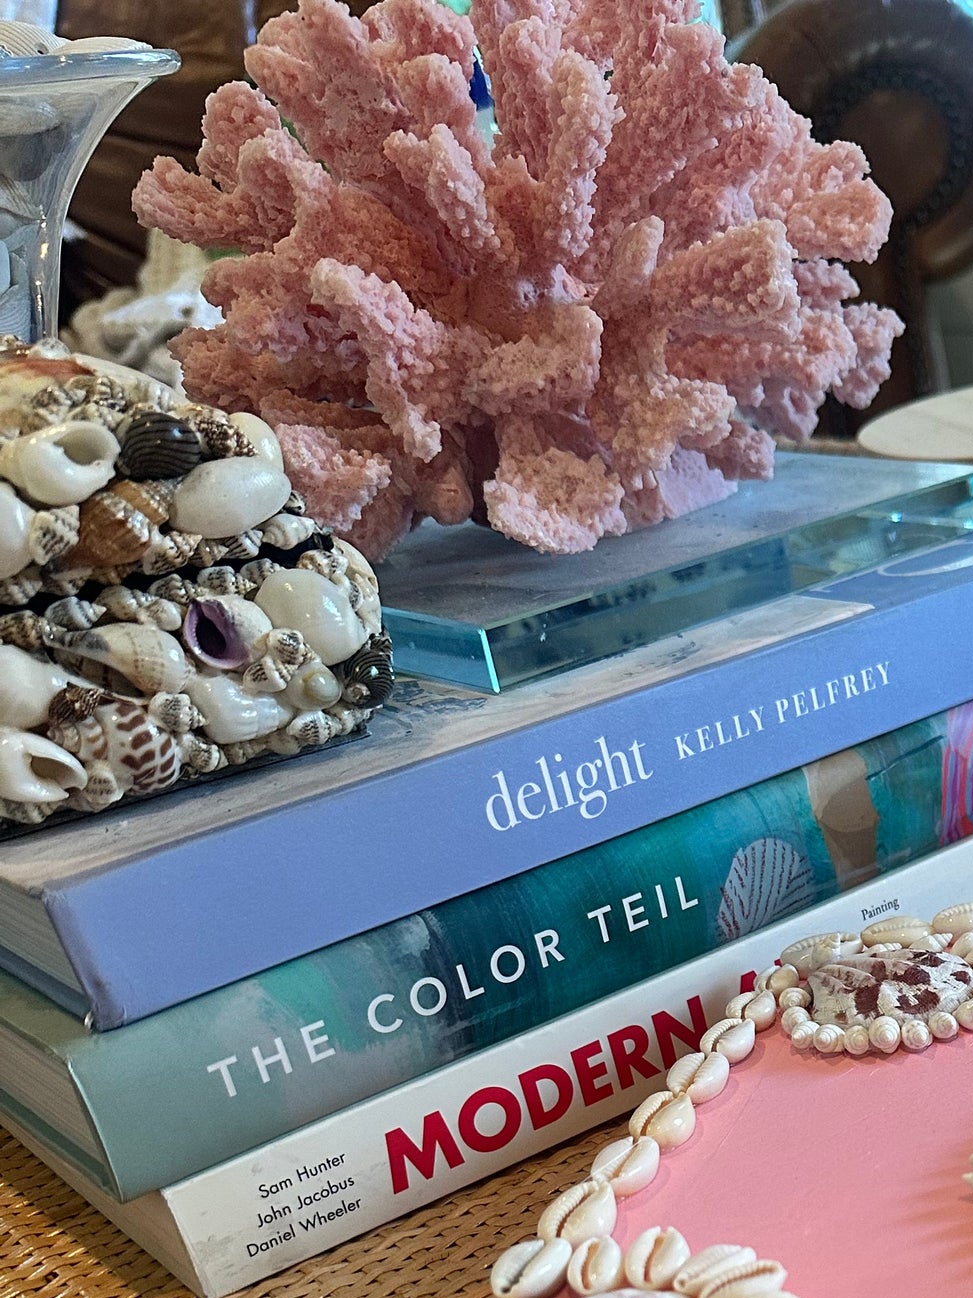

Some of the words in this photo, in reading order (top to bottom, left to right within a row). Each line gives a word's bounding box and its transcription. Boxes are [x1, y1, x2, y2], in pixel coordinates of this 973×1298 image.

[674, 706, 767, 761] KELLY
[775, 661, 892, 723] PELFREY
[485, 736, 654, 832] delight
[860, 898, 900, 921] Painting
[206, 1019, 337, 1098] THE
[367, 928, 566, 1034] COLOR
[586, 876, 699, 943] TEIL
[385, 995, 708, 1195] MODERN
[257, 1205, 292, 1228] John
[297, 1176, 355, 1210] Jacobus
[258, 1177, 293, 1199] Sam
[296, 1153, 346, 1182] Hunter
[246, 1223, 296, 1258] Daniel
[298, 1198, 362, 1232] Wheeler
